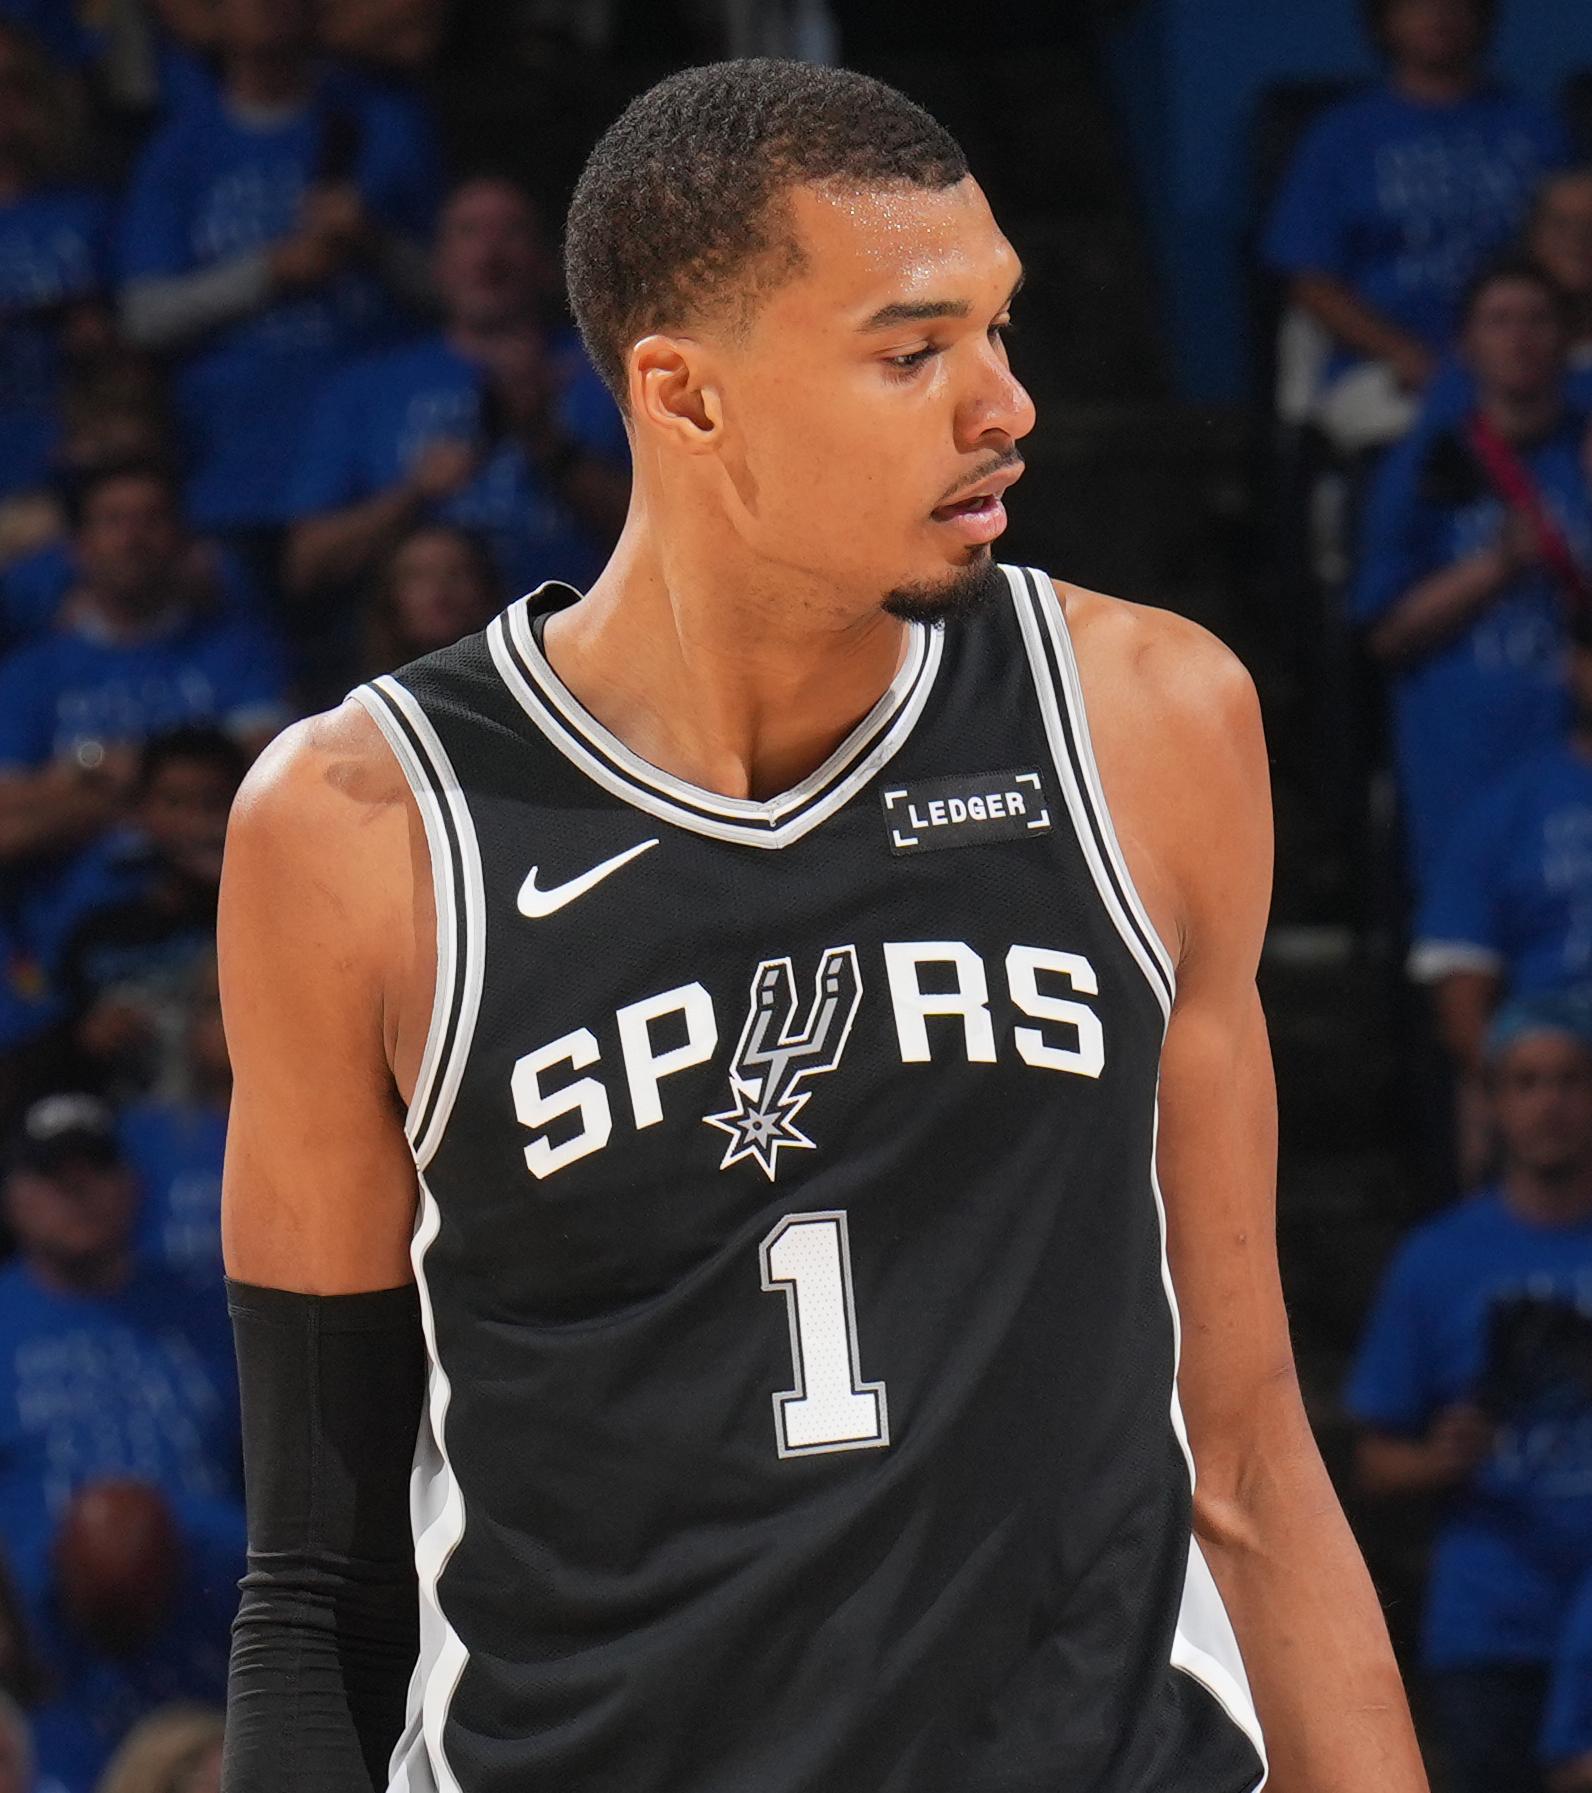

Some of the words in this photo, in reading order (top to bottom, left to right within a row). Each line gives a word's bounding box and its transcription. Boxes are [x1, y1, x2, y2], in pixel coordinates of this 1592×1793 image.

[908, 791, 1027, 830] LEDGER
[510, 940, 1106, 1181] SPURS
[759, 1210, 890, 1459] 1
